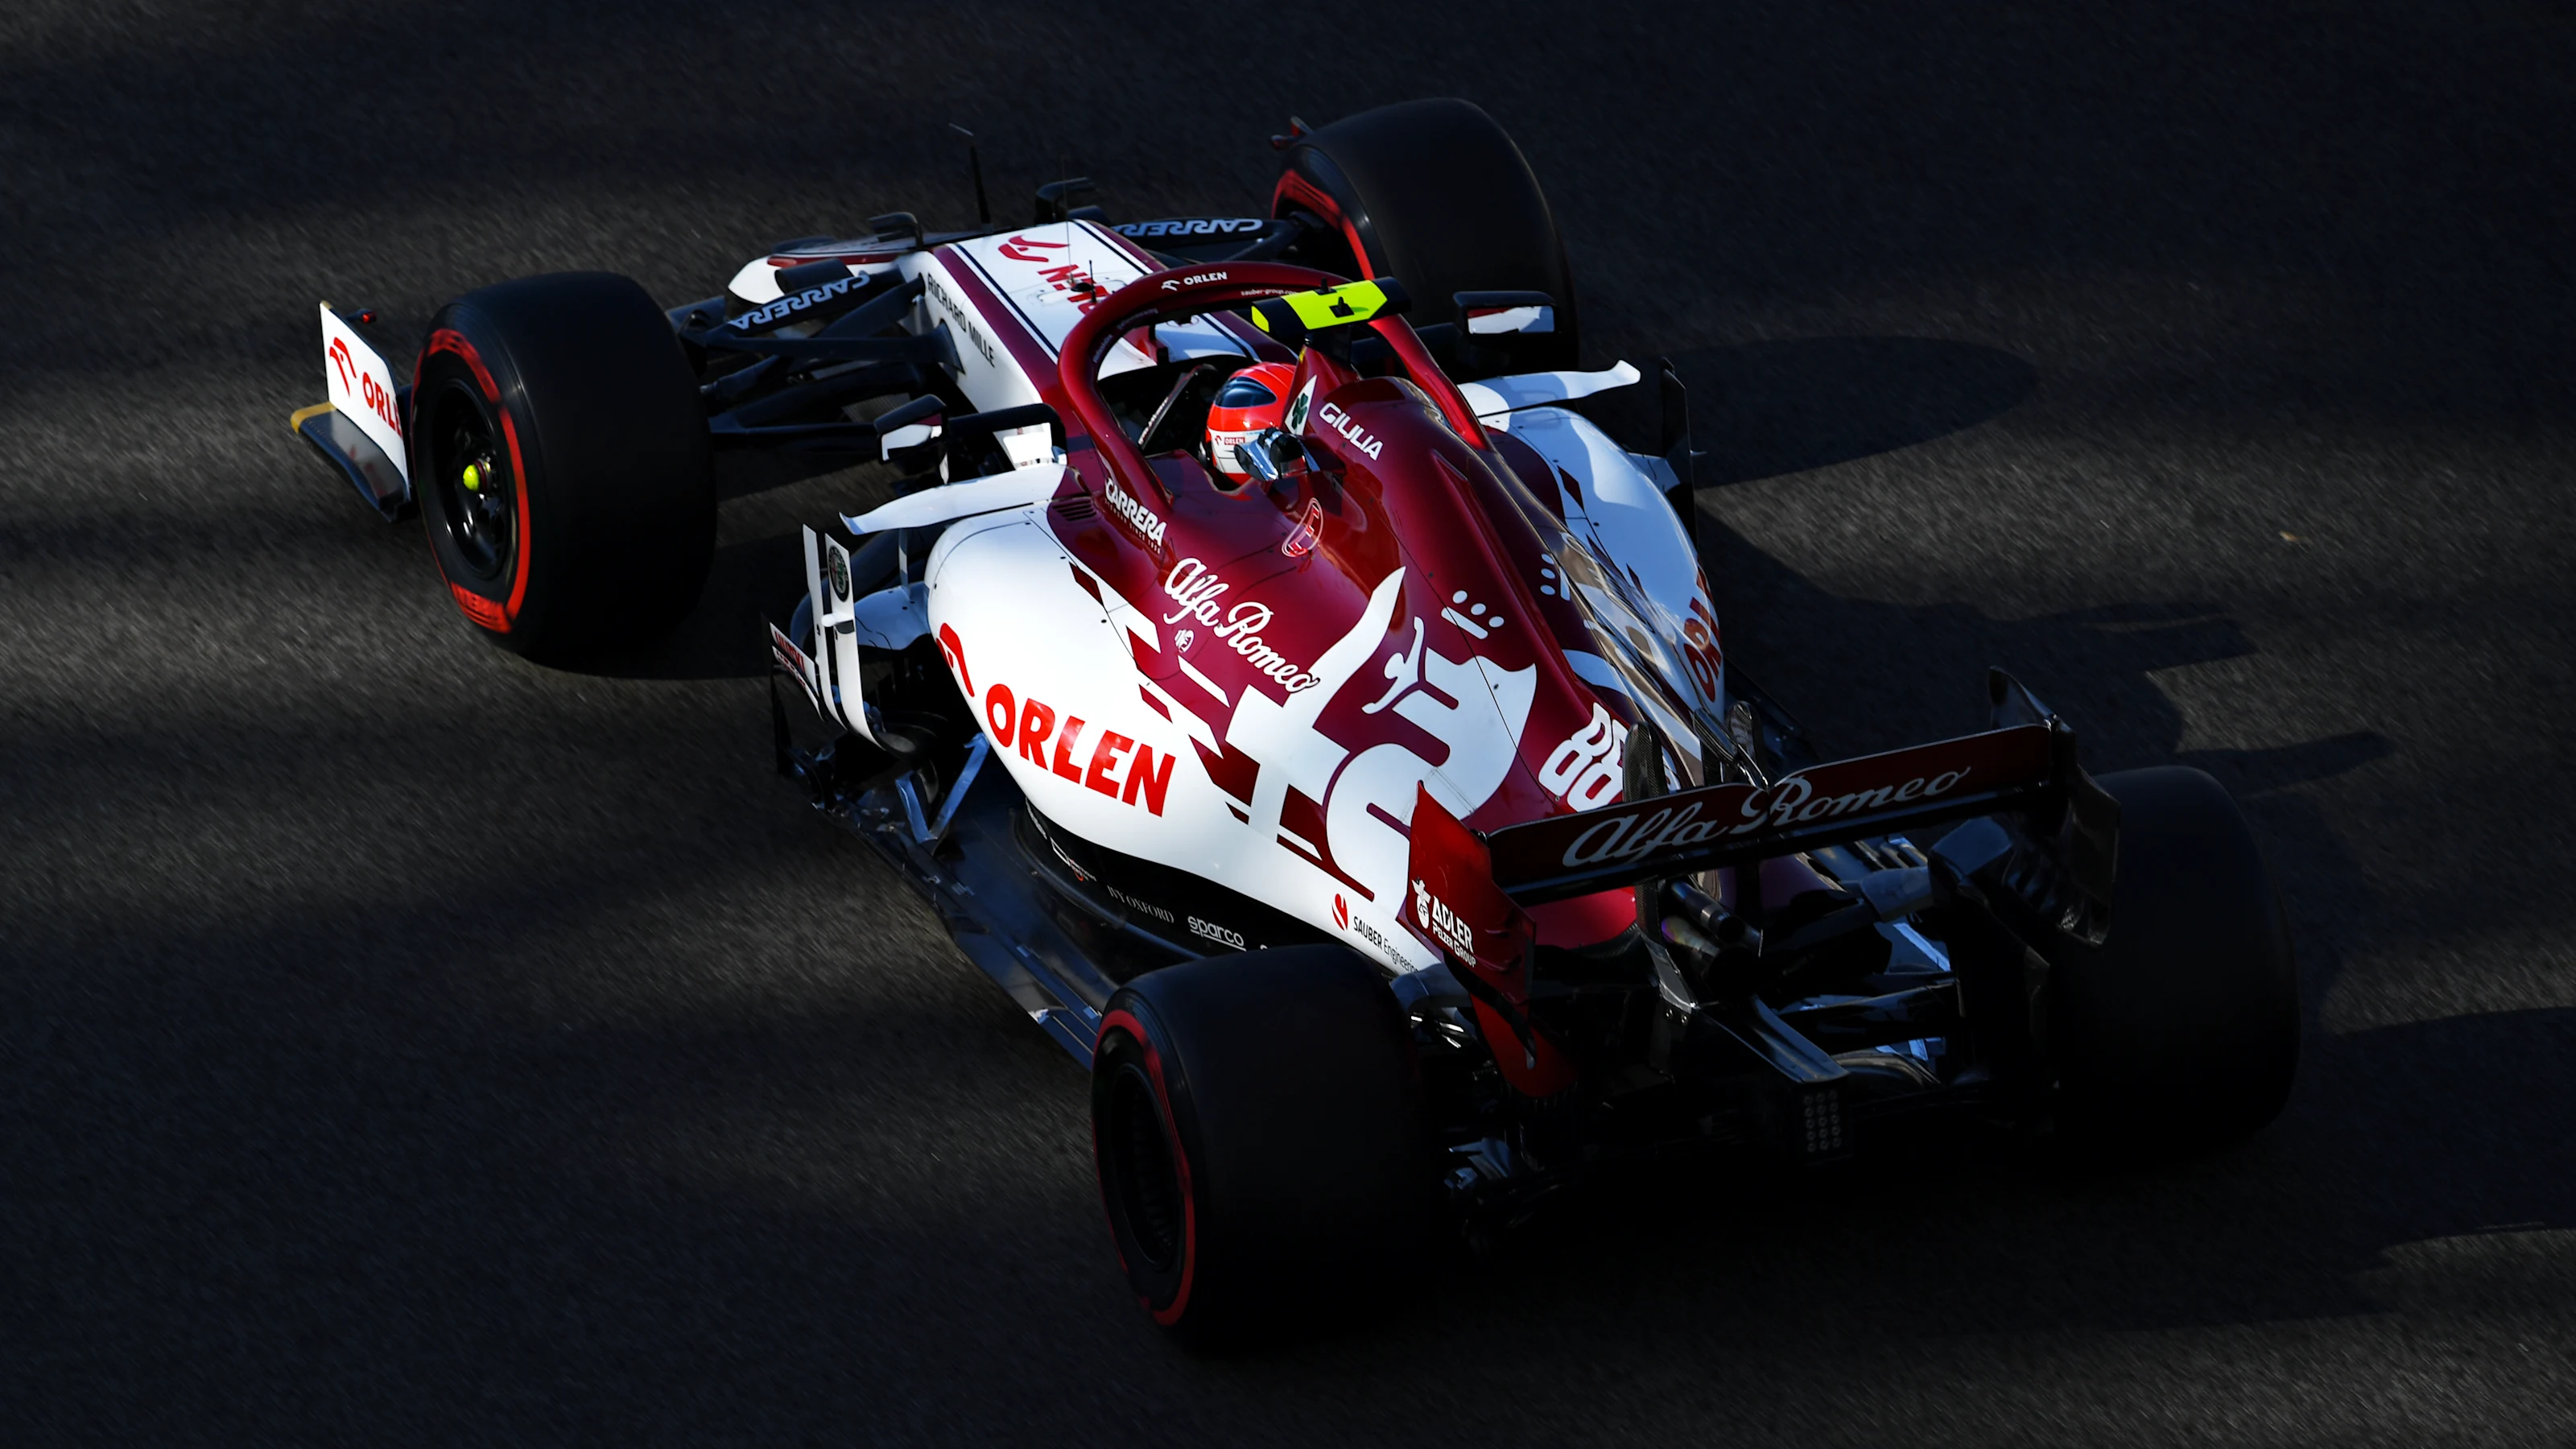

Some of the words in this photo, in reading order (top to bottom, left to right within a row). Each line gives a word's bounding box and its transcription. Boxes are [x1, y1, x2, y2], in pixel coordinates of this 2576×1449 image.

[726, 270, 871, 330] CARRERA
[1183, 271, 1228, 286] ORLEN
[927, 271, 967, 333] RICHARD
[968, 320, 996, 369] MILLE
[1224, 437, 1245, 445] ORLEN
[1319, 402, 1384, 461] GIULIA
[1104, 477, 1167, 547] CARRERA
[1163, 557, 1229, 626] Alfa
[1214, 601, 1320, 693] Romeo
[985, 683, 1176, 818] ORLEN
[1538, 702, 1630, 813] 88
[1563, 801, 1731, 867] Alfa
[1728, 766, 1971, 836] Romeo
[1126, 894, 1174, 923] OXFORD
[1187, 915, 1246, 952] sparco
[1353, 915, 1383, 950] SAUBER
[1432, 895, 1474, 954] ADLER
